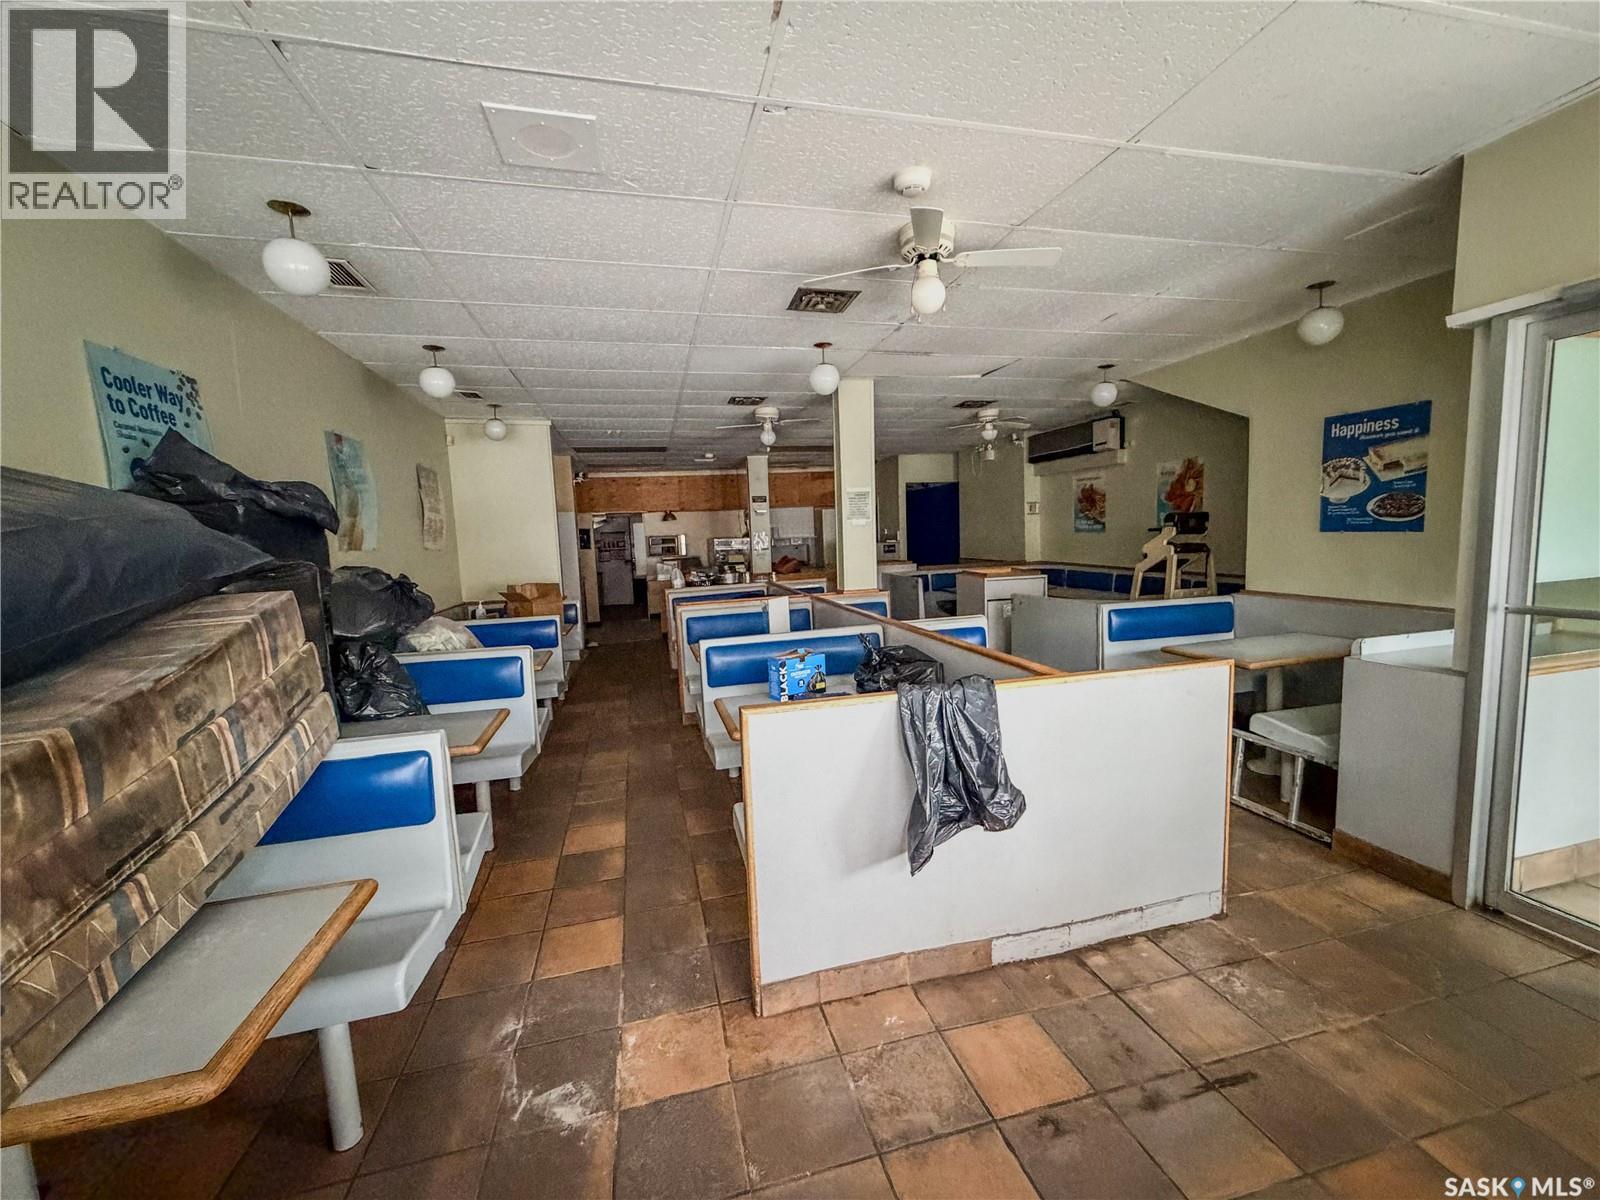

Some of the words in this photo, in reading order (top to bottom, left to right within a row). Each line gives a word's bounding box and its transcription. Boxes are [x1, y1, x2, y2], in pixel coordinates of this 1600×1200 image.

[100, 366, 152, 400] Cooler
[154, 382, 184, 413] Way
[106, 394, 126, 416] to
[128, 397, 176, 426] Coffee
[1331, 417, 1400, 439] Happiness
[779, 666, 789, 702] BLACK
